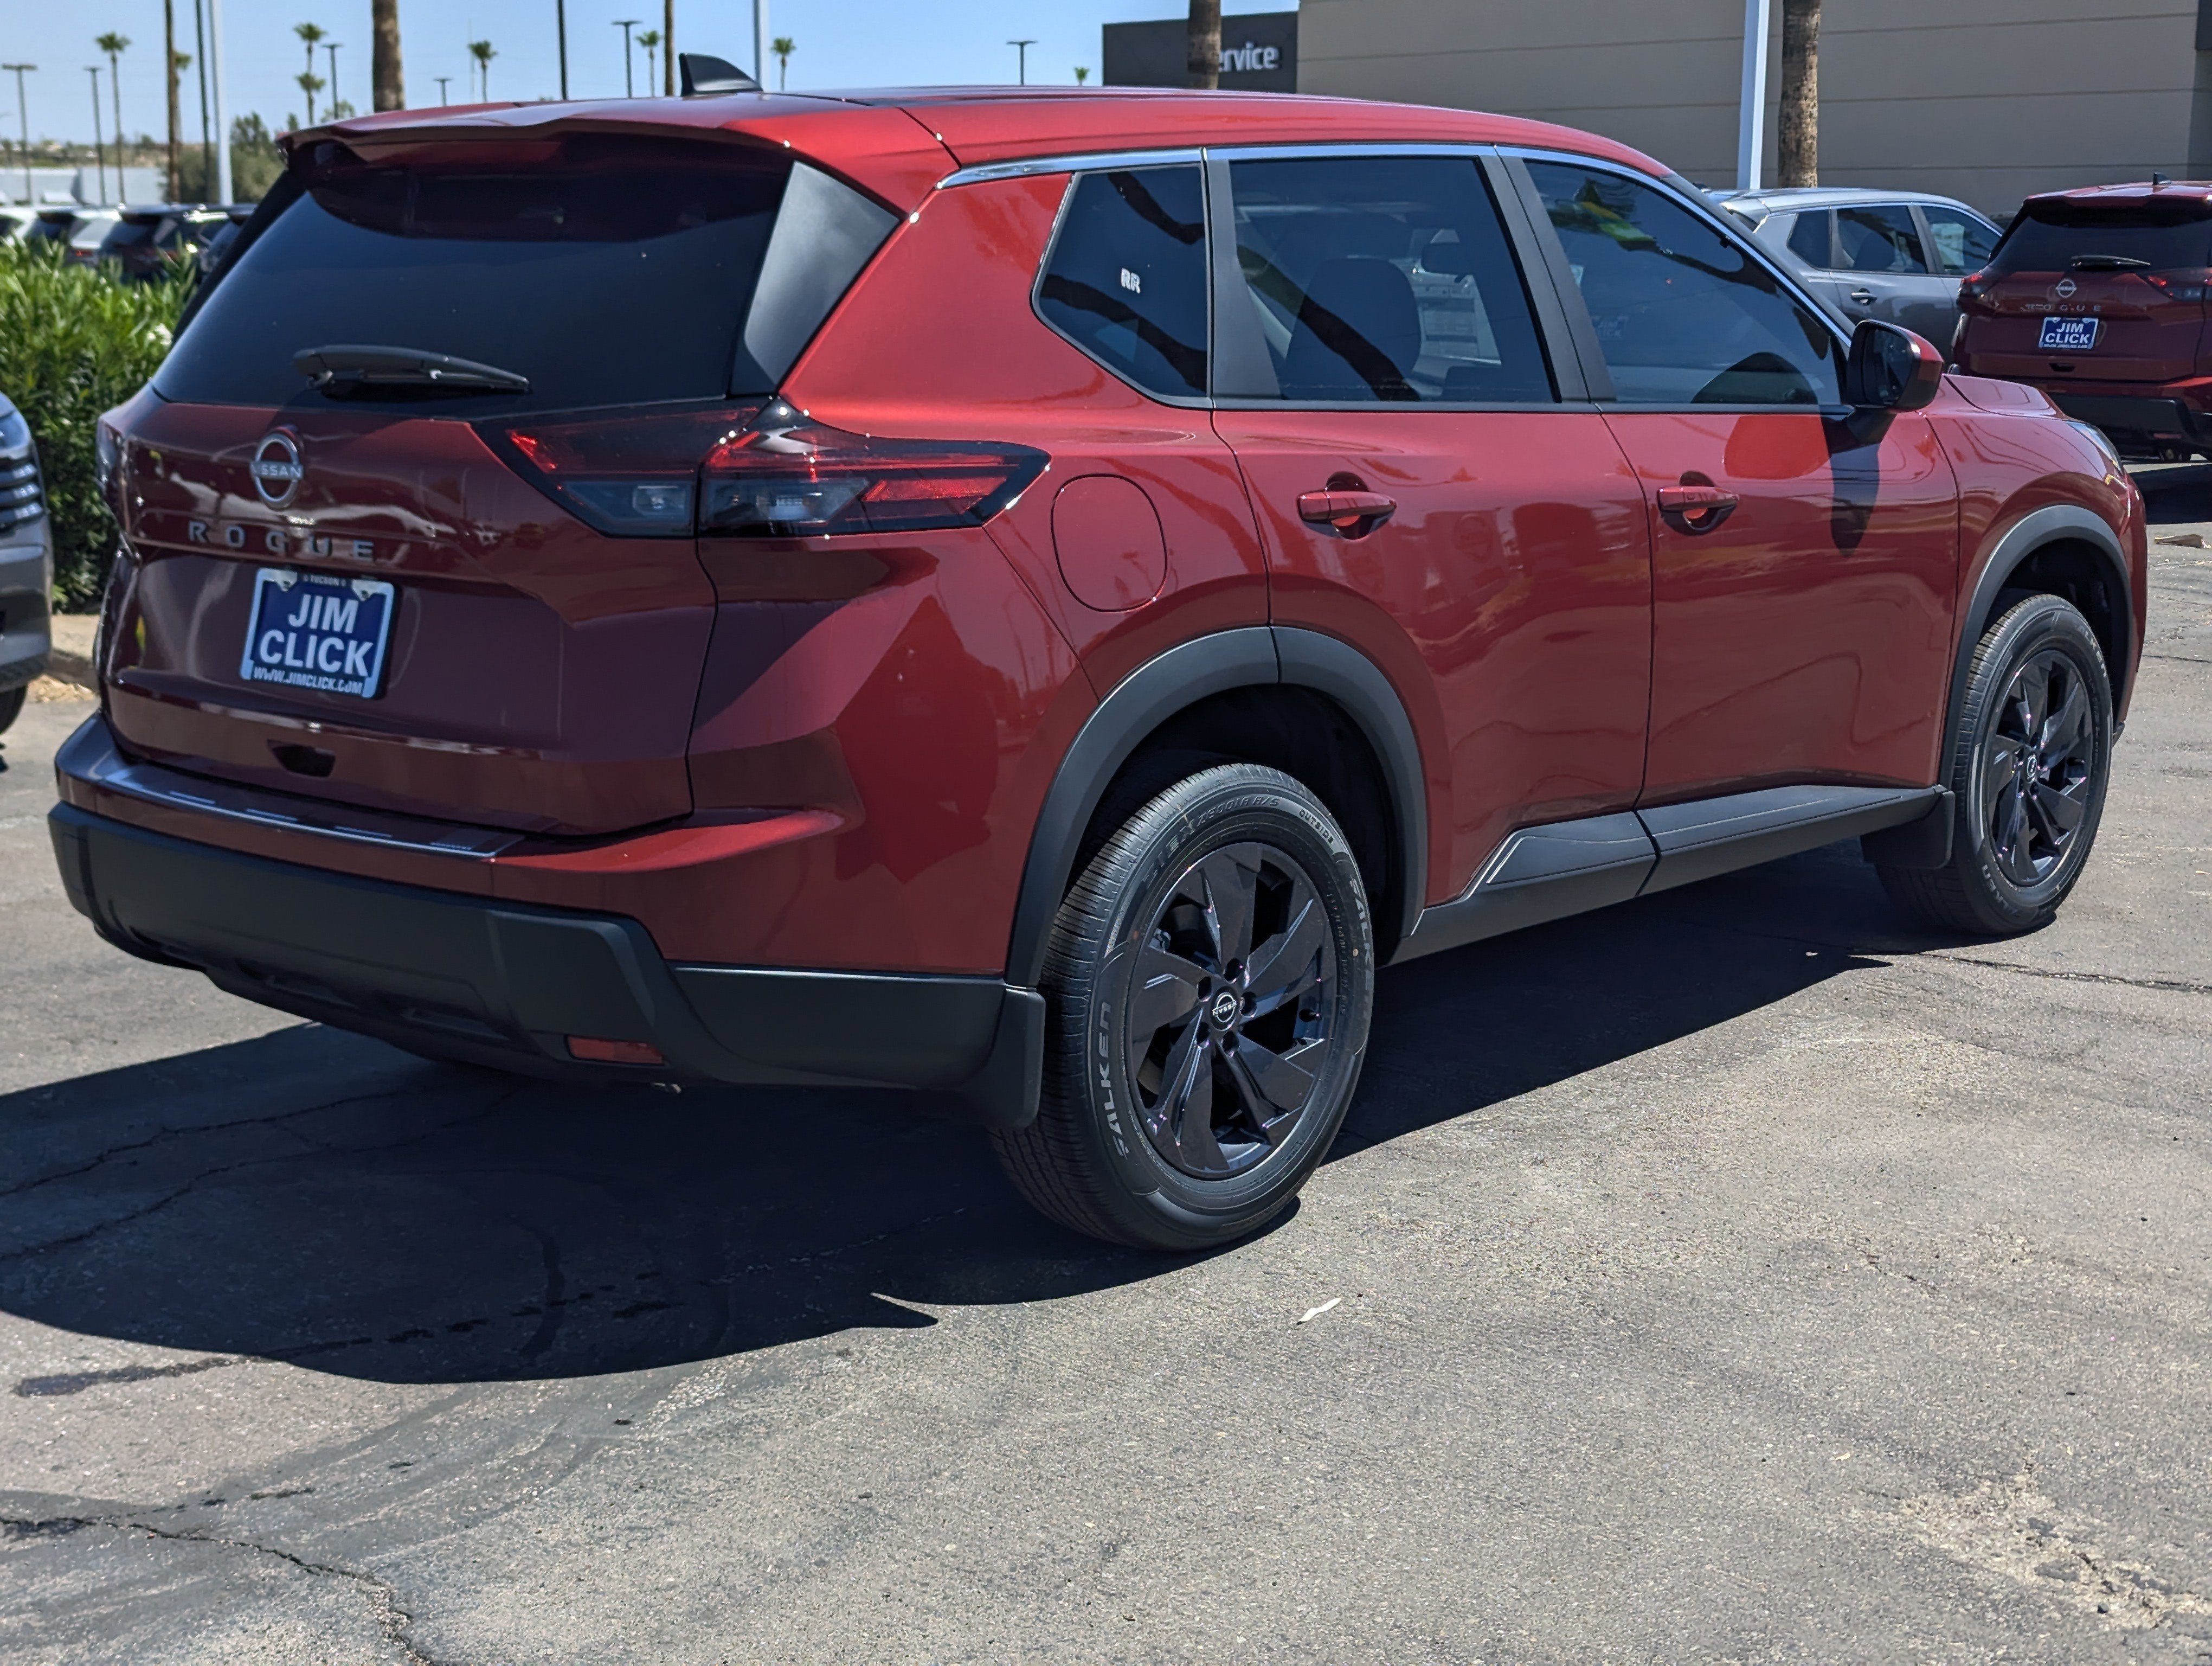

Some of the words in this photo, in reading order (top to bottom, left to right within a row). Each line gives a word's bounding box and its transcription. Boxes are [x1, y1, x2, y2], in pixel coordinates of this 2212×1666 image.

[1218, 41, 1279, 72] ervice
[1121, 268, 1140, 293] RR
[2045, 333, 2091, 344] CLICK
[2056, 323, 2084, 333] JIM
[250, 463, 302, 478] NSSAN
[188, 520, 375, 561] ROGUE
[288, 594, 359, 634] JIM
[260, 629, 374, 677] CLICK
[253, 665, 364, 695] WWW.JIMCLICK.COM
[1298, 809, 1334, 844] OUTSIDE
[1212, 999, 1237, 1016] NISSAN
